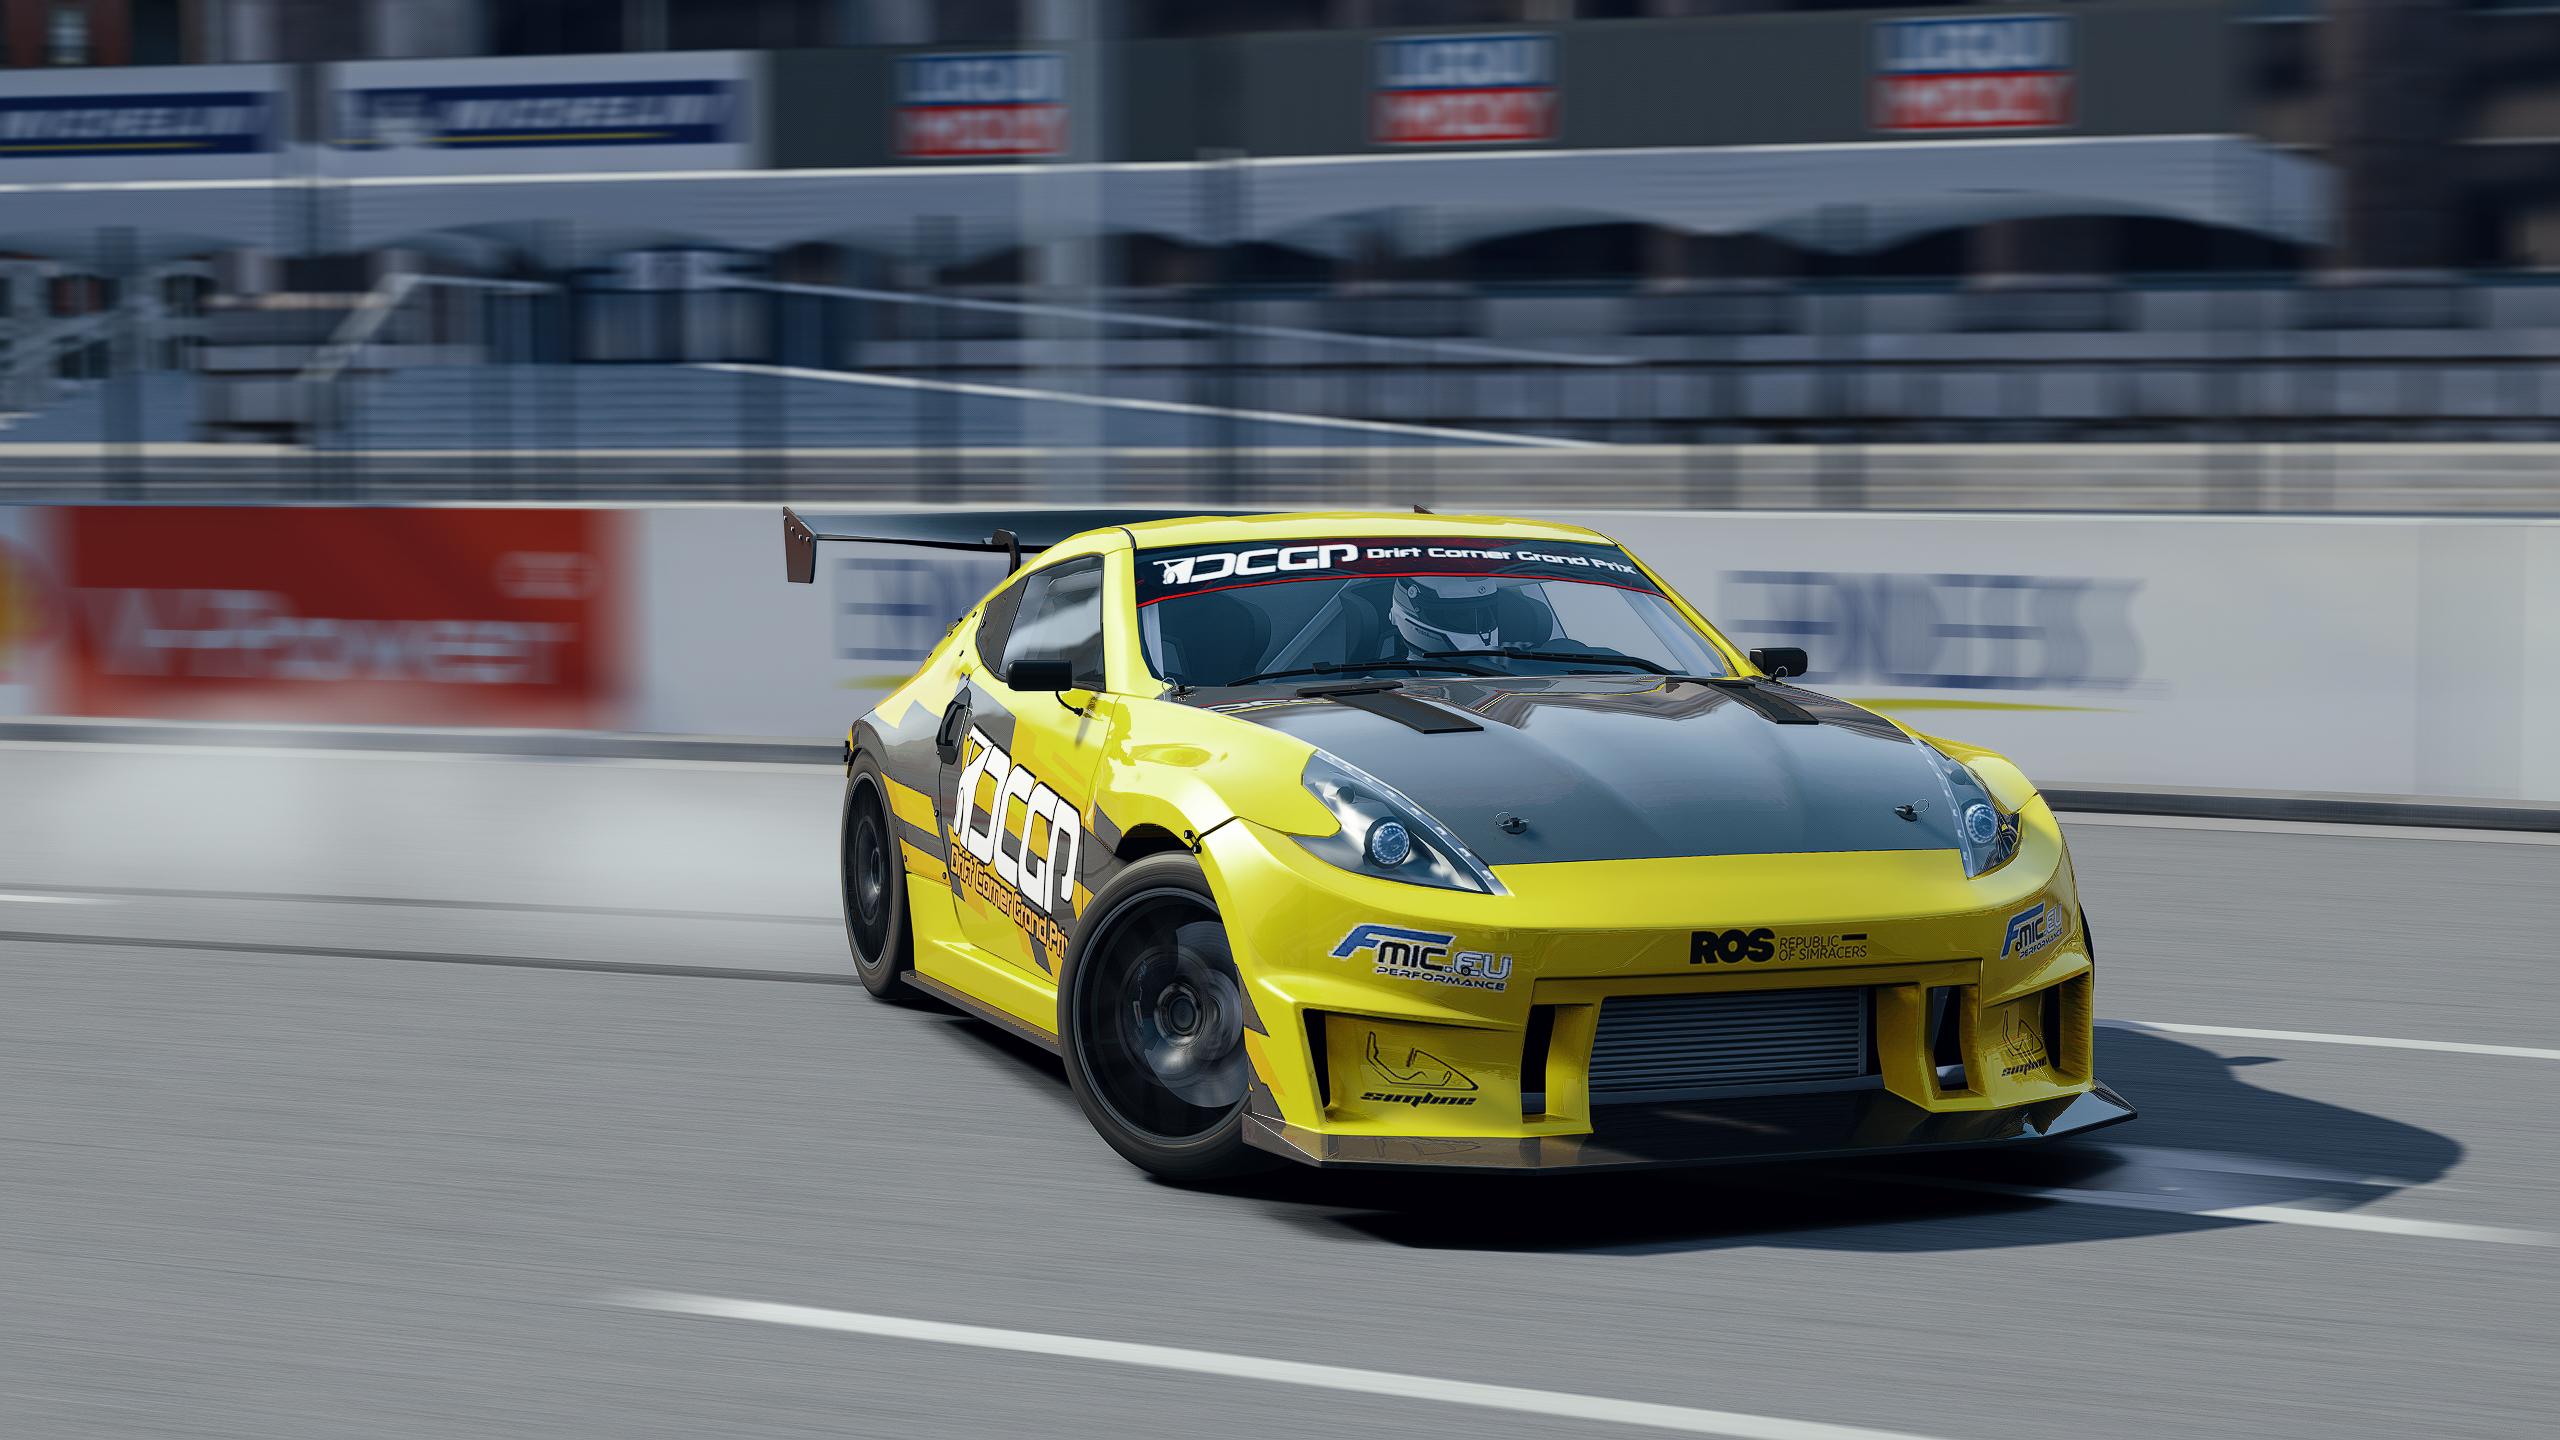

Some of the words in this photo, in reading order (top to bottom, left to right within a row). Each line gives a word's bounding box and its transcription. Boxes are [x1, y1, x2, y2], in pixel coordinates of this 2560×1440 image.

[1175, 543, 1359, 584] DCGP
[1367, 547, 1422, 559] Drift
[1427, 547, 1513, 561] Corner
[1517, 550, 1590, 566] Grand
[1590, 558, 1638, 575] Prix
[960, 738, 1081, 915] DCGP
[950, 843, 976, 888] Drift
[975, 861, 1013, 918] Corner
[1013, 890, 1048, 947] Grand
[1690, 928, 1776, 964] ROS
[1779, 935, 1840, 950] REPUBLIC
[1779, 949, 1796, 962] OF
[1799, 945, 1868, 961] SIMRACERS
[1376, 966, 1507, 991] PERFORMANCE
